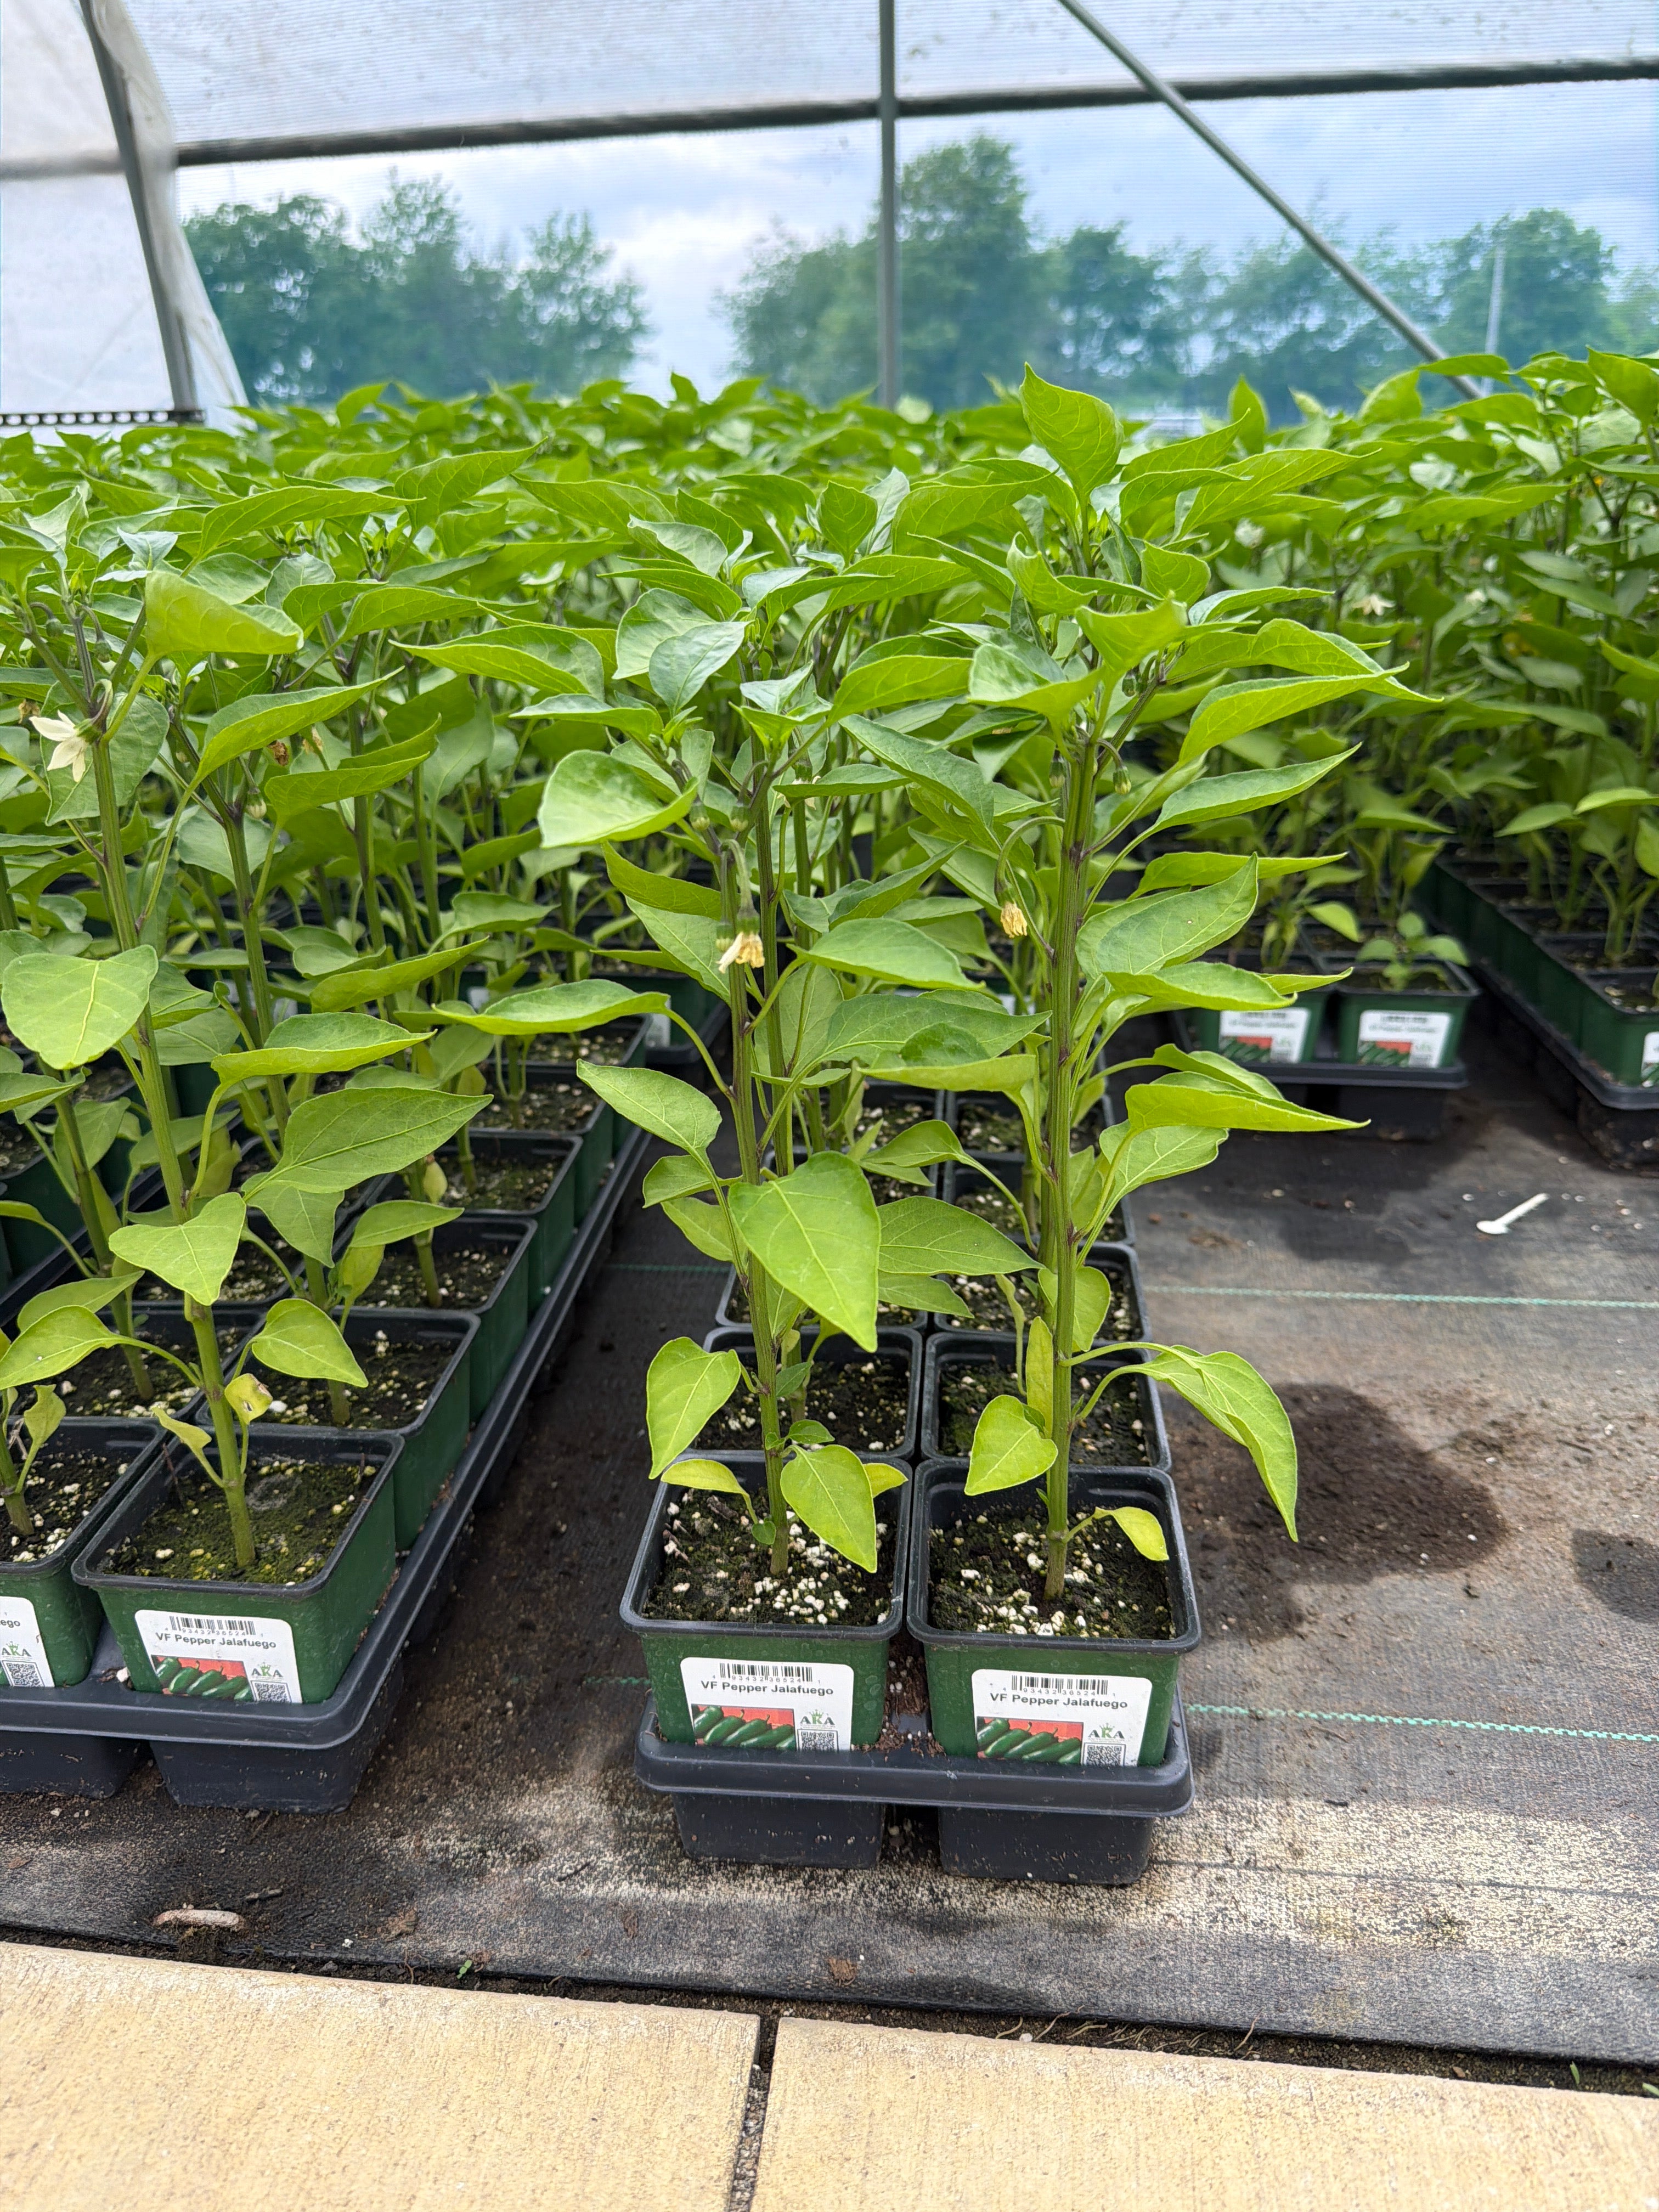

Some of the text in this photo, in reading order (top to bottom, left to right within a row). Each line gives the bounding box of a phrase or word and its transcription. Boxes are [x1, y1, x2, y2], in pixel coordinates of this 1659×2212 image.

[0, 1620, 20, 1628] ego
[155, 1633, 276, 1649] VF Pepper Jalafuego
[701, 1680, 833, 1696] VF Pepper Jalafuego
[990, 1693, 1128, 1709] VF Pepper Jalafuego
